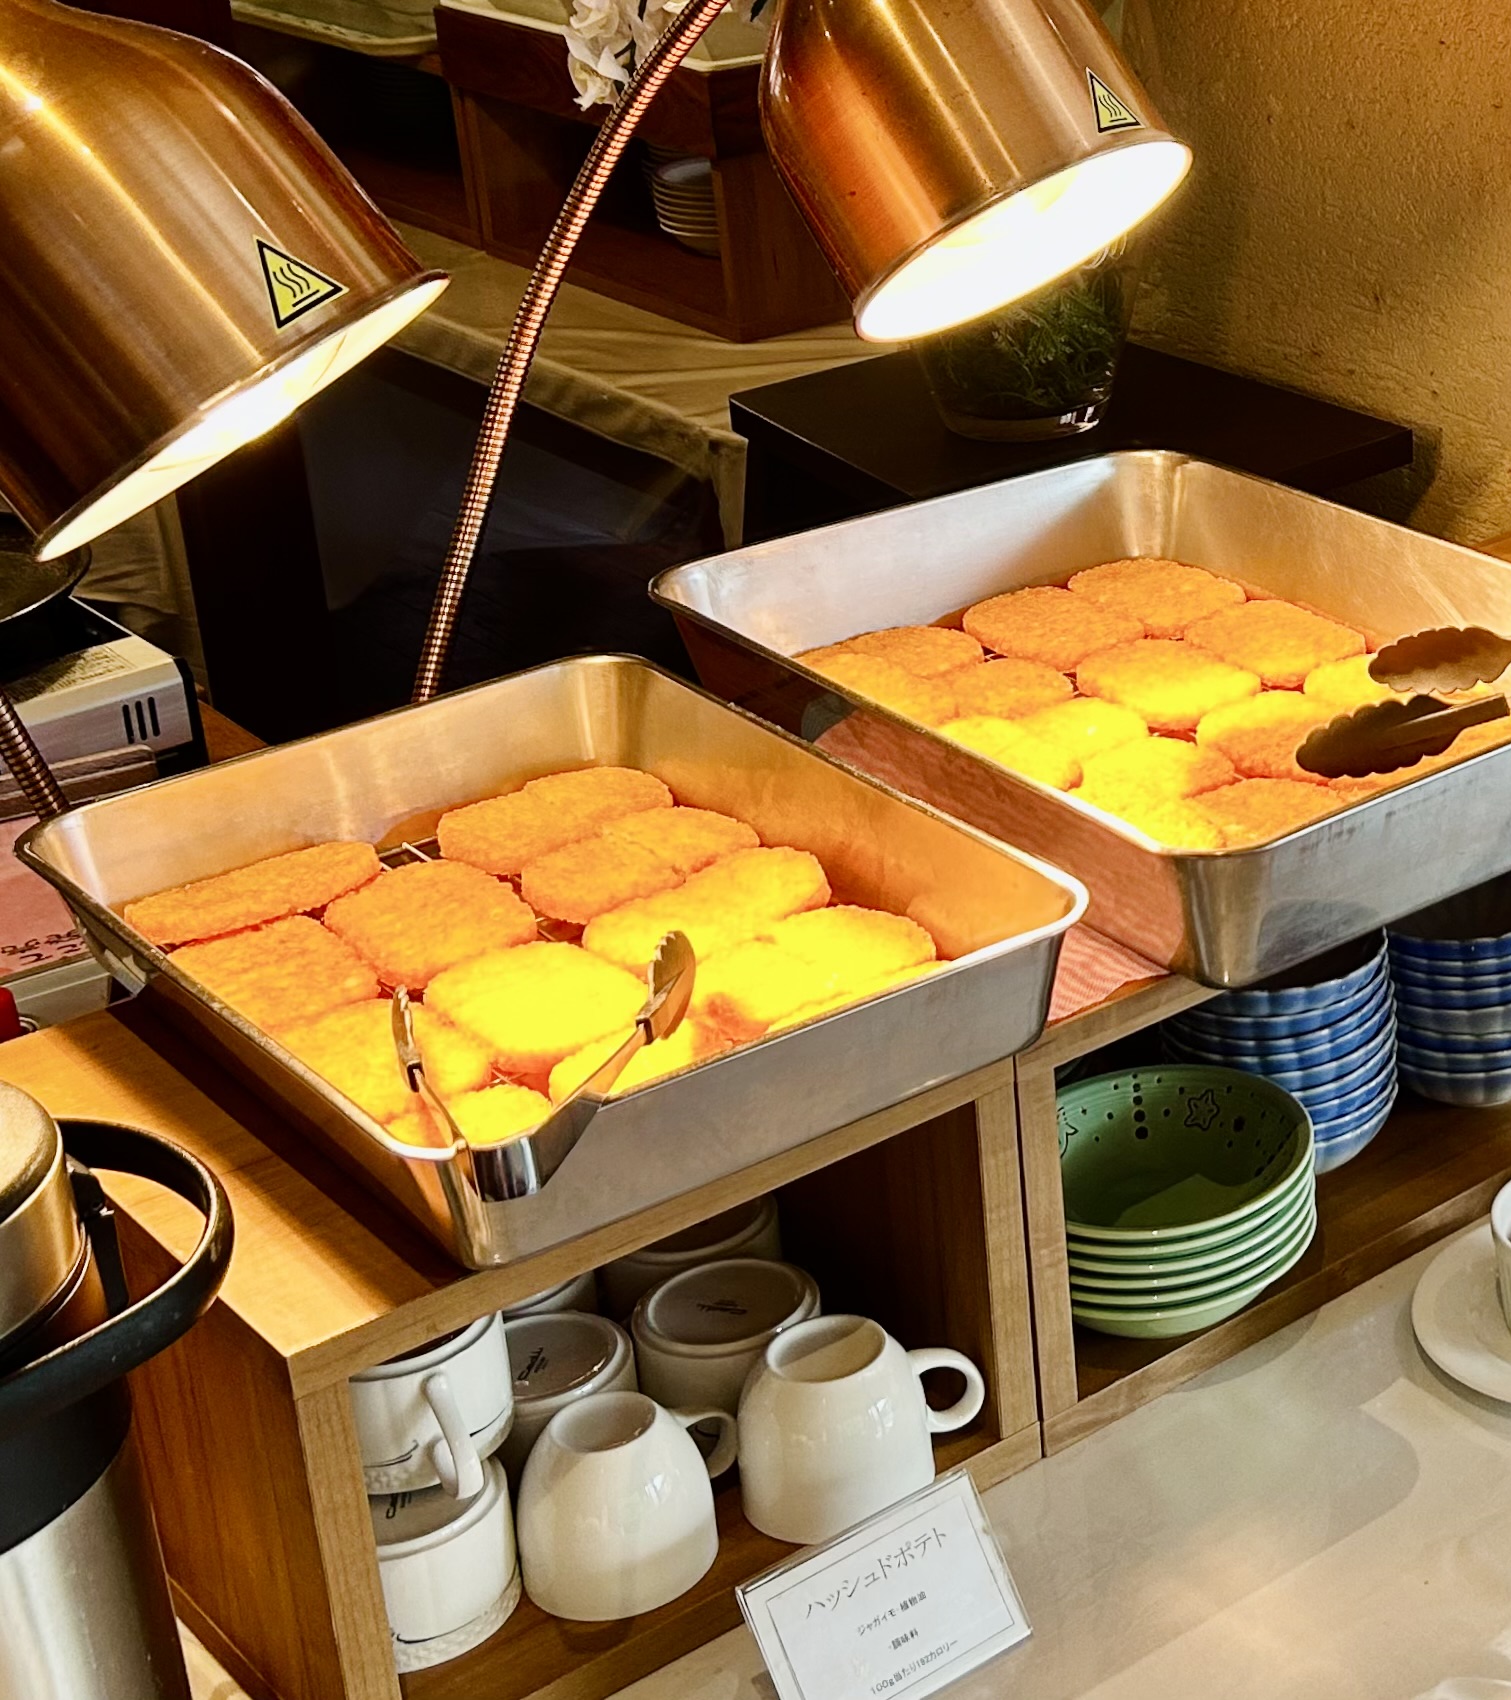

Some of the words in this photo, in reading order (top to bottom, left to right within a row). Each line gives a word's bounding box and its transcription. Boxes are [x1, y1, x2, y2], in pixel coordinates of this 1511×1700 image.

[805, 1527, 947, 1620] ハッシュドポテト
